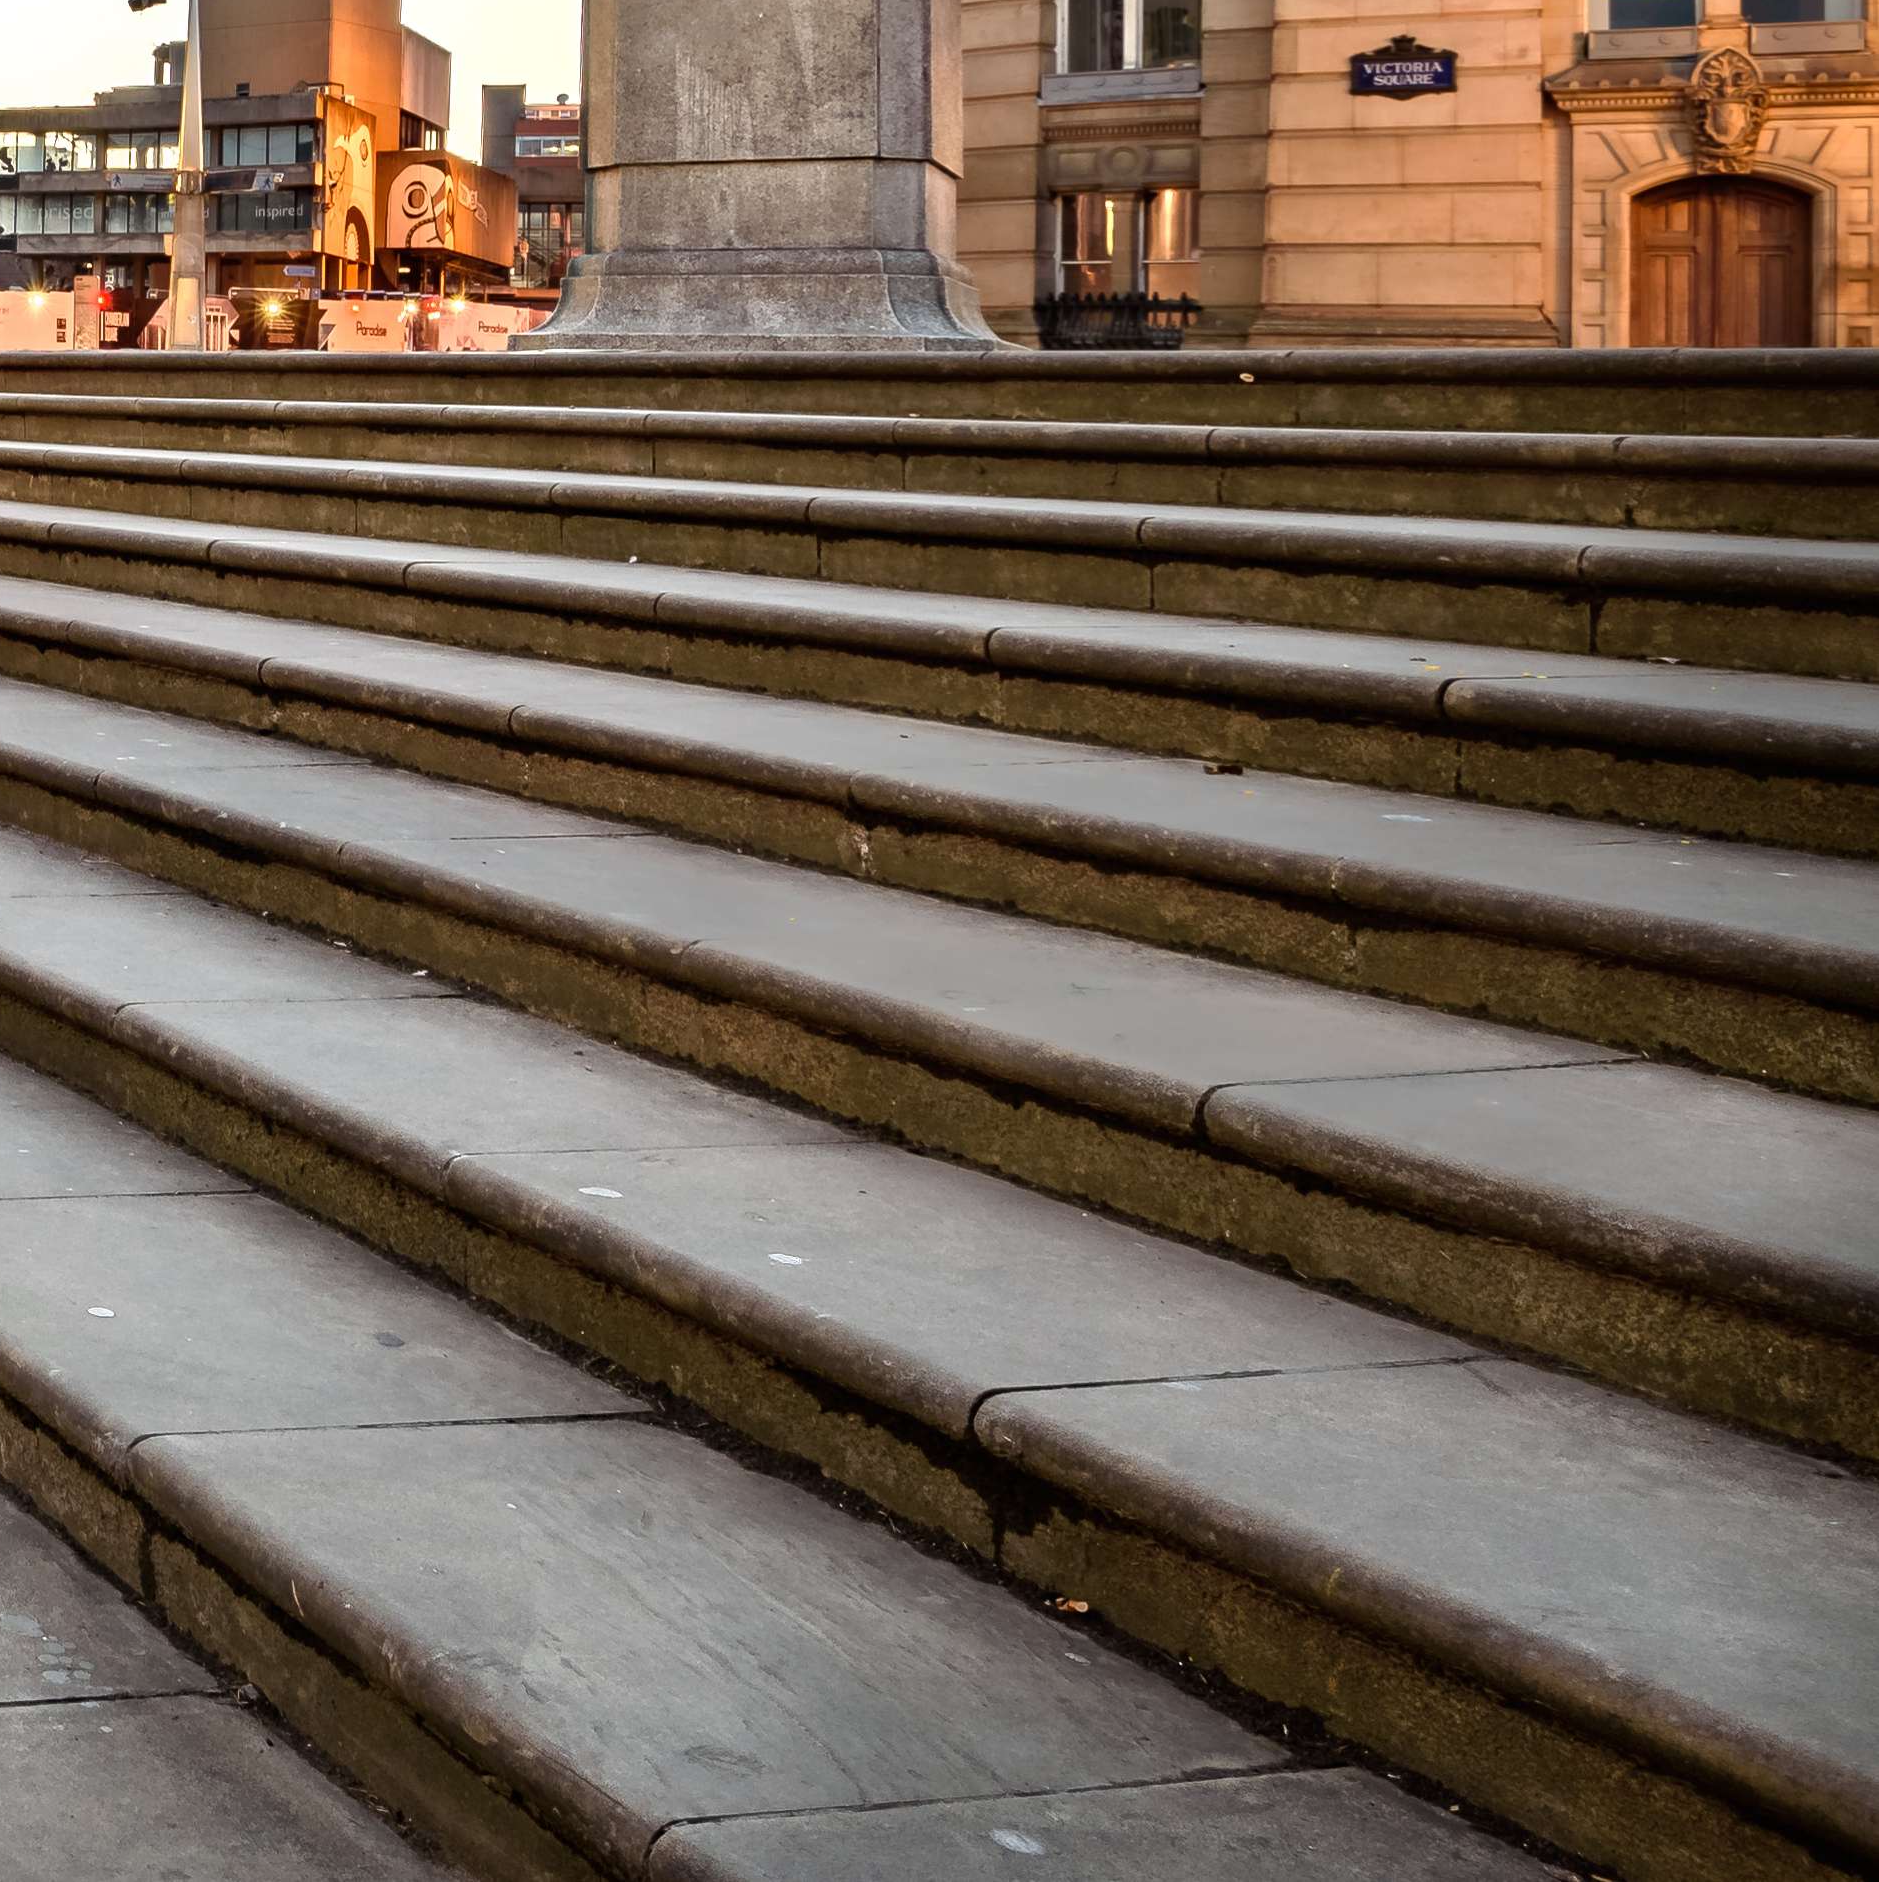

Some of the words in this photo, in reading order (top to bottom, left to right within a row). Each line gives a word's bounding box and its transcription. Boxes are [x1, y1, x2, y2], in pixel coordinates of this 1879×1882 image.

[1364, 61, 1443, 74] VICTORIA
[1373, 73, 1434, 85] SQUARE
[255, 204, 304, 220] inspired
[356, 320, 387, 336] Paradise
[478, 320, 509, 334] Paradise
